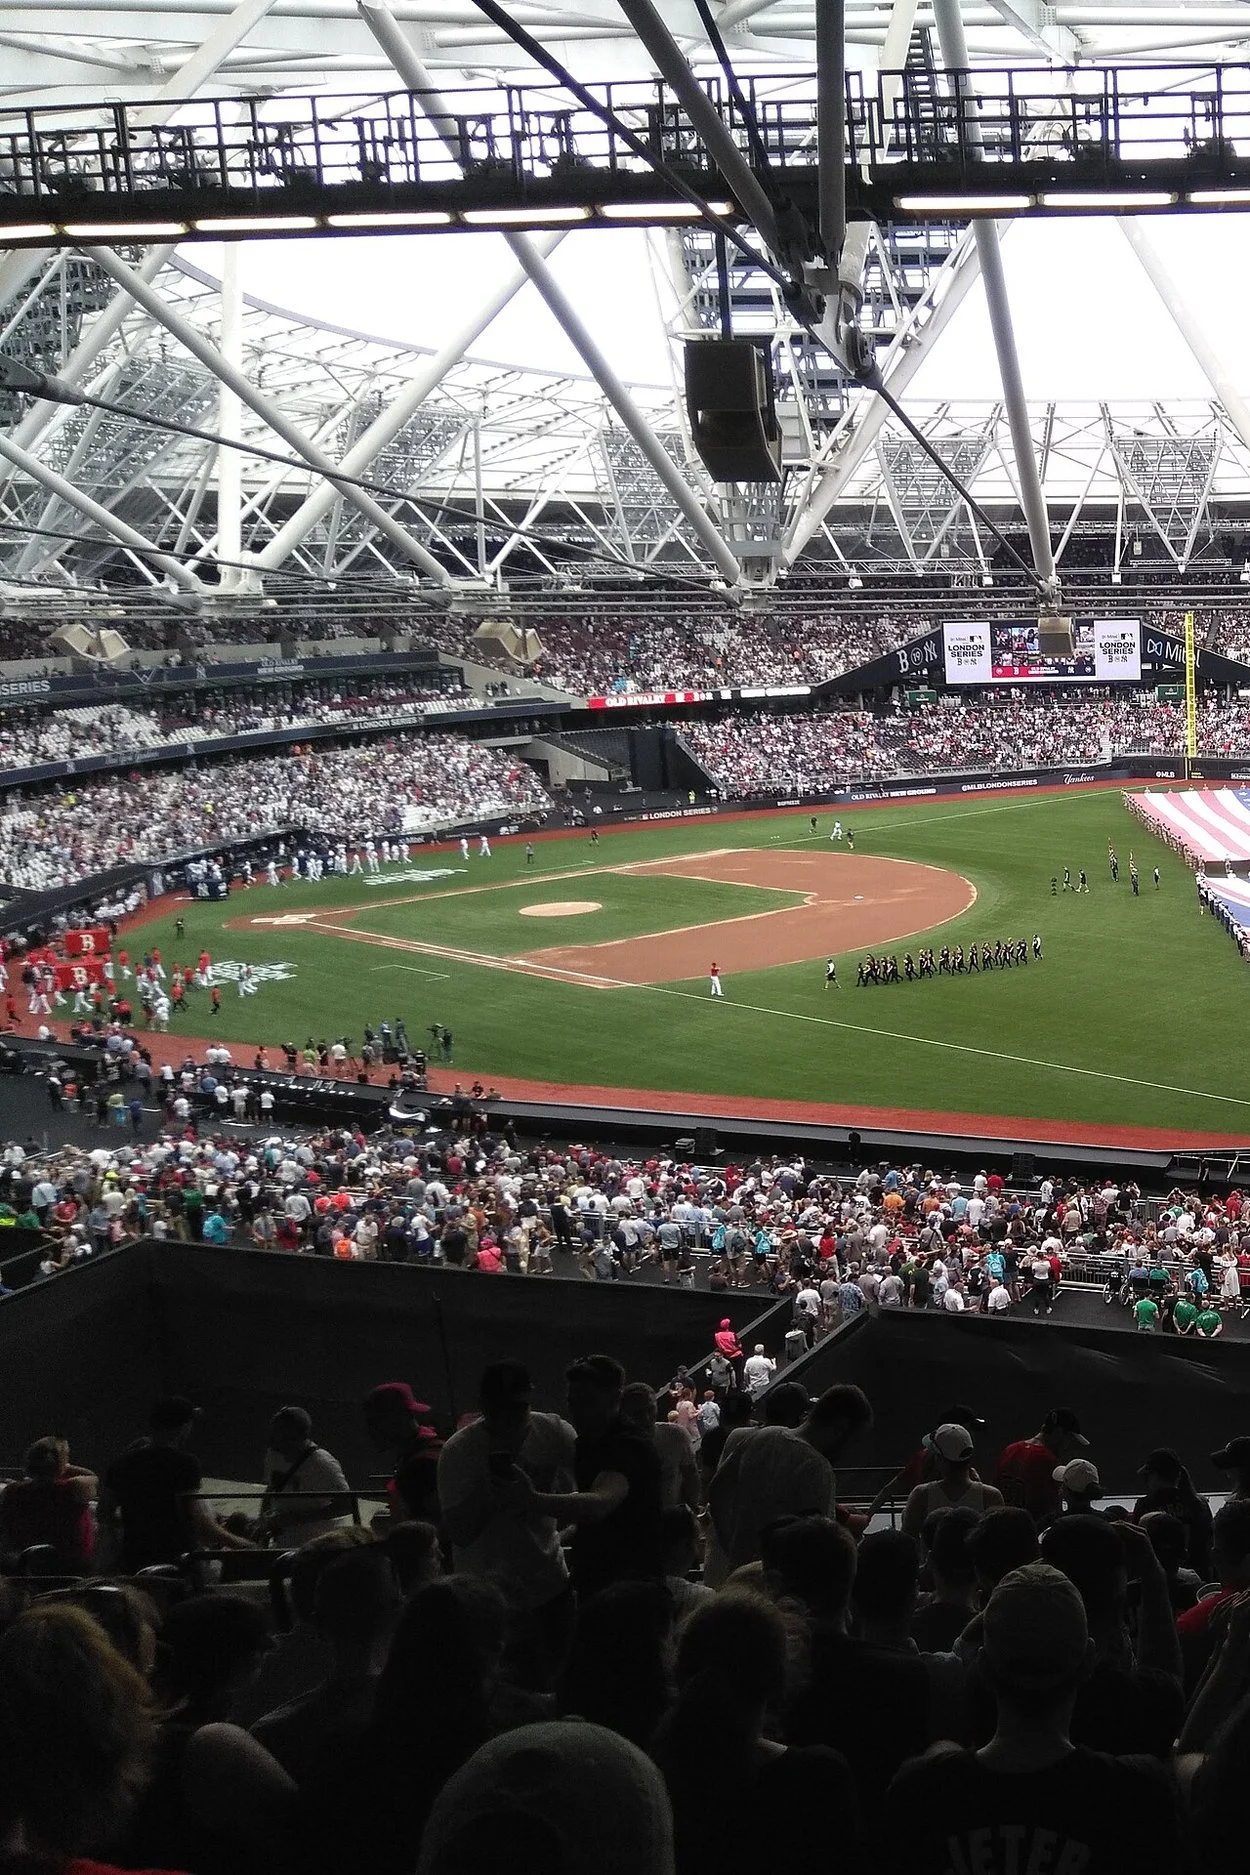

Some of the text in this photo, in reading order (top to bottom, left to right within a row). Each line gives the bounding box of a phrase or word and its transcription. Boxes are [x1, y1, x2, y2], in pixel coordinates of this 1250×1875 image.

[1099, 641, 1136, 649] LONDON
[950, 650, 983, 658] SERIES
[1165, 641, 1200, 668] Mitl
[1, 680, 50, 695] SERIES
[606, 696, 626, 707] OLD
[627, 694, 666, 705] RIVALRY
[360, 719, 390, 729] LONDON
[1063, 773, 1095, 784] Yankees
[961, 779, 1038, 791] @MLBLONDONSERIES
[649, 807, 711, 820] LONDON SERIES
